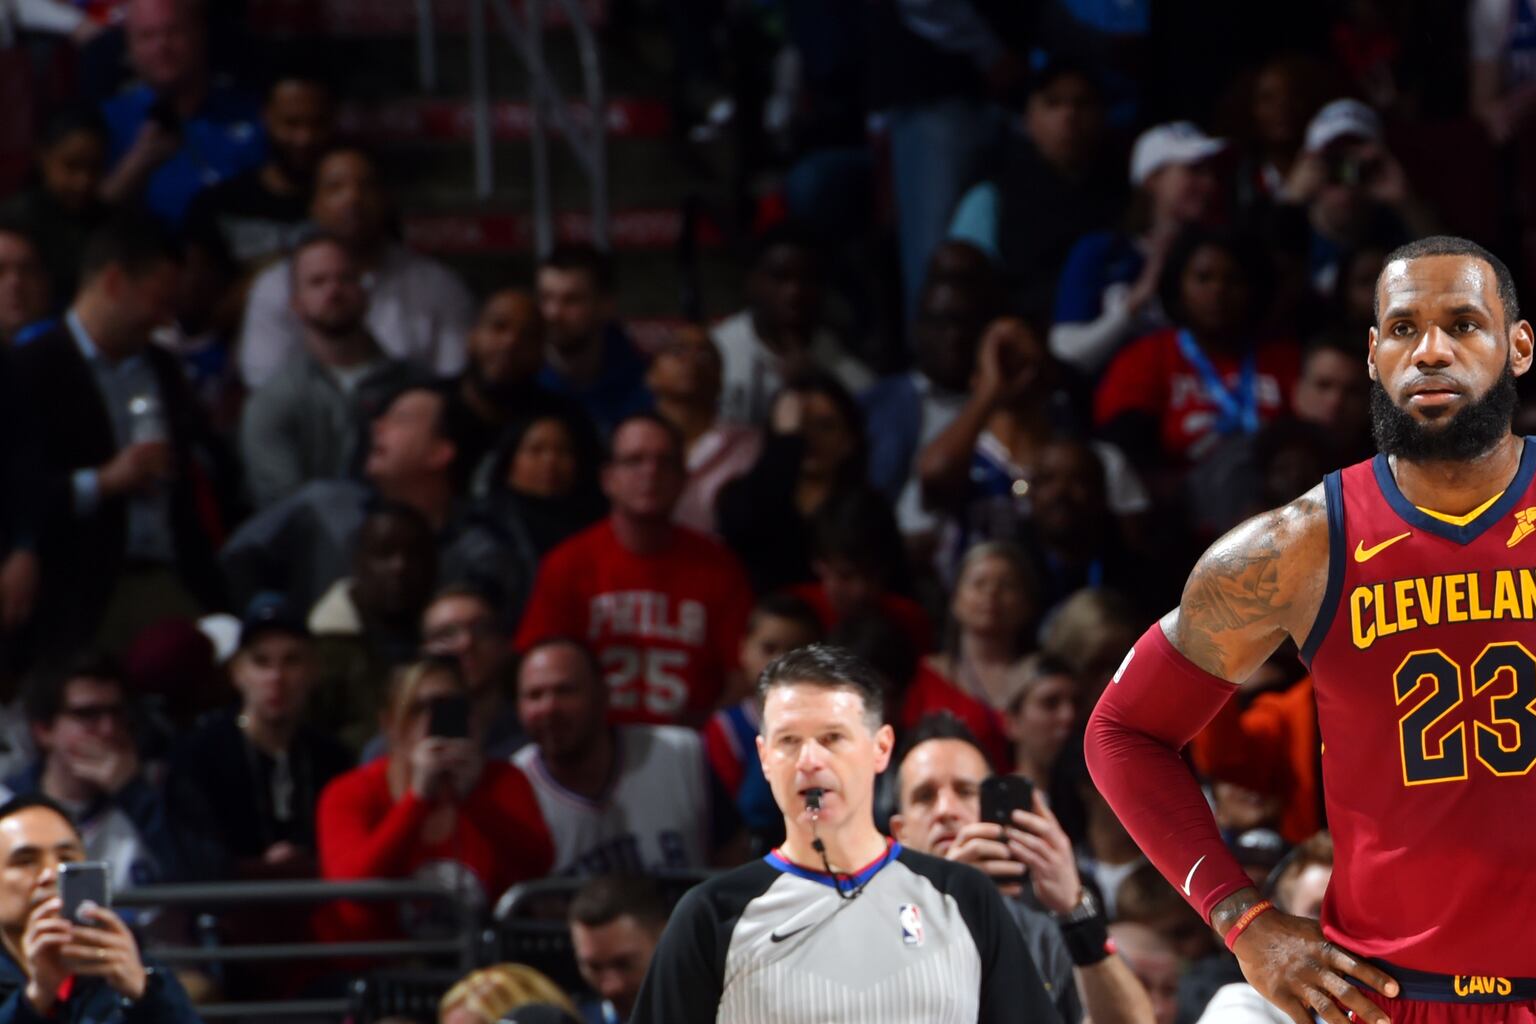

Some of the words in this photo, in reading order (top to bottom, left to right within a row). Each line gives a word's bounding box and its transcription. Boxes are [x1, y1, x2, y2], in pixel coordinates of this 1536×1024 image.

[587, 591, 706, 648] PHILA
[600, 644, 689, 715] 25
[1454, 975, 1512, 997] CAVS
